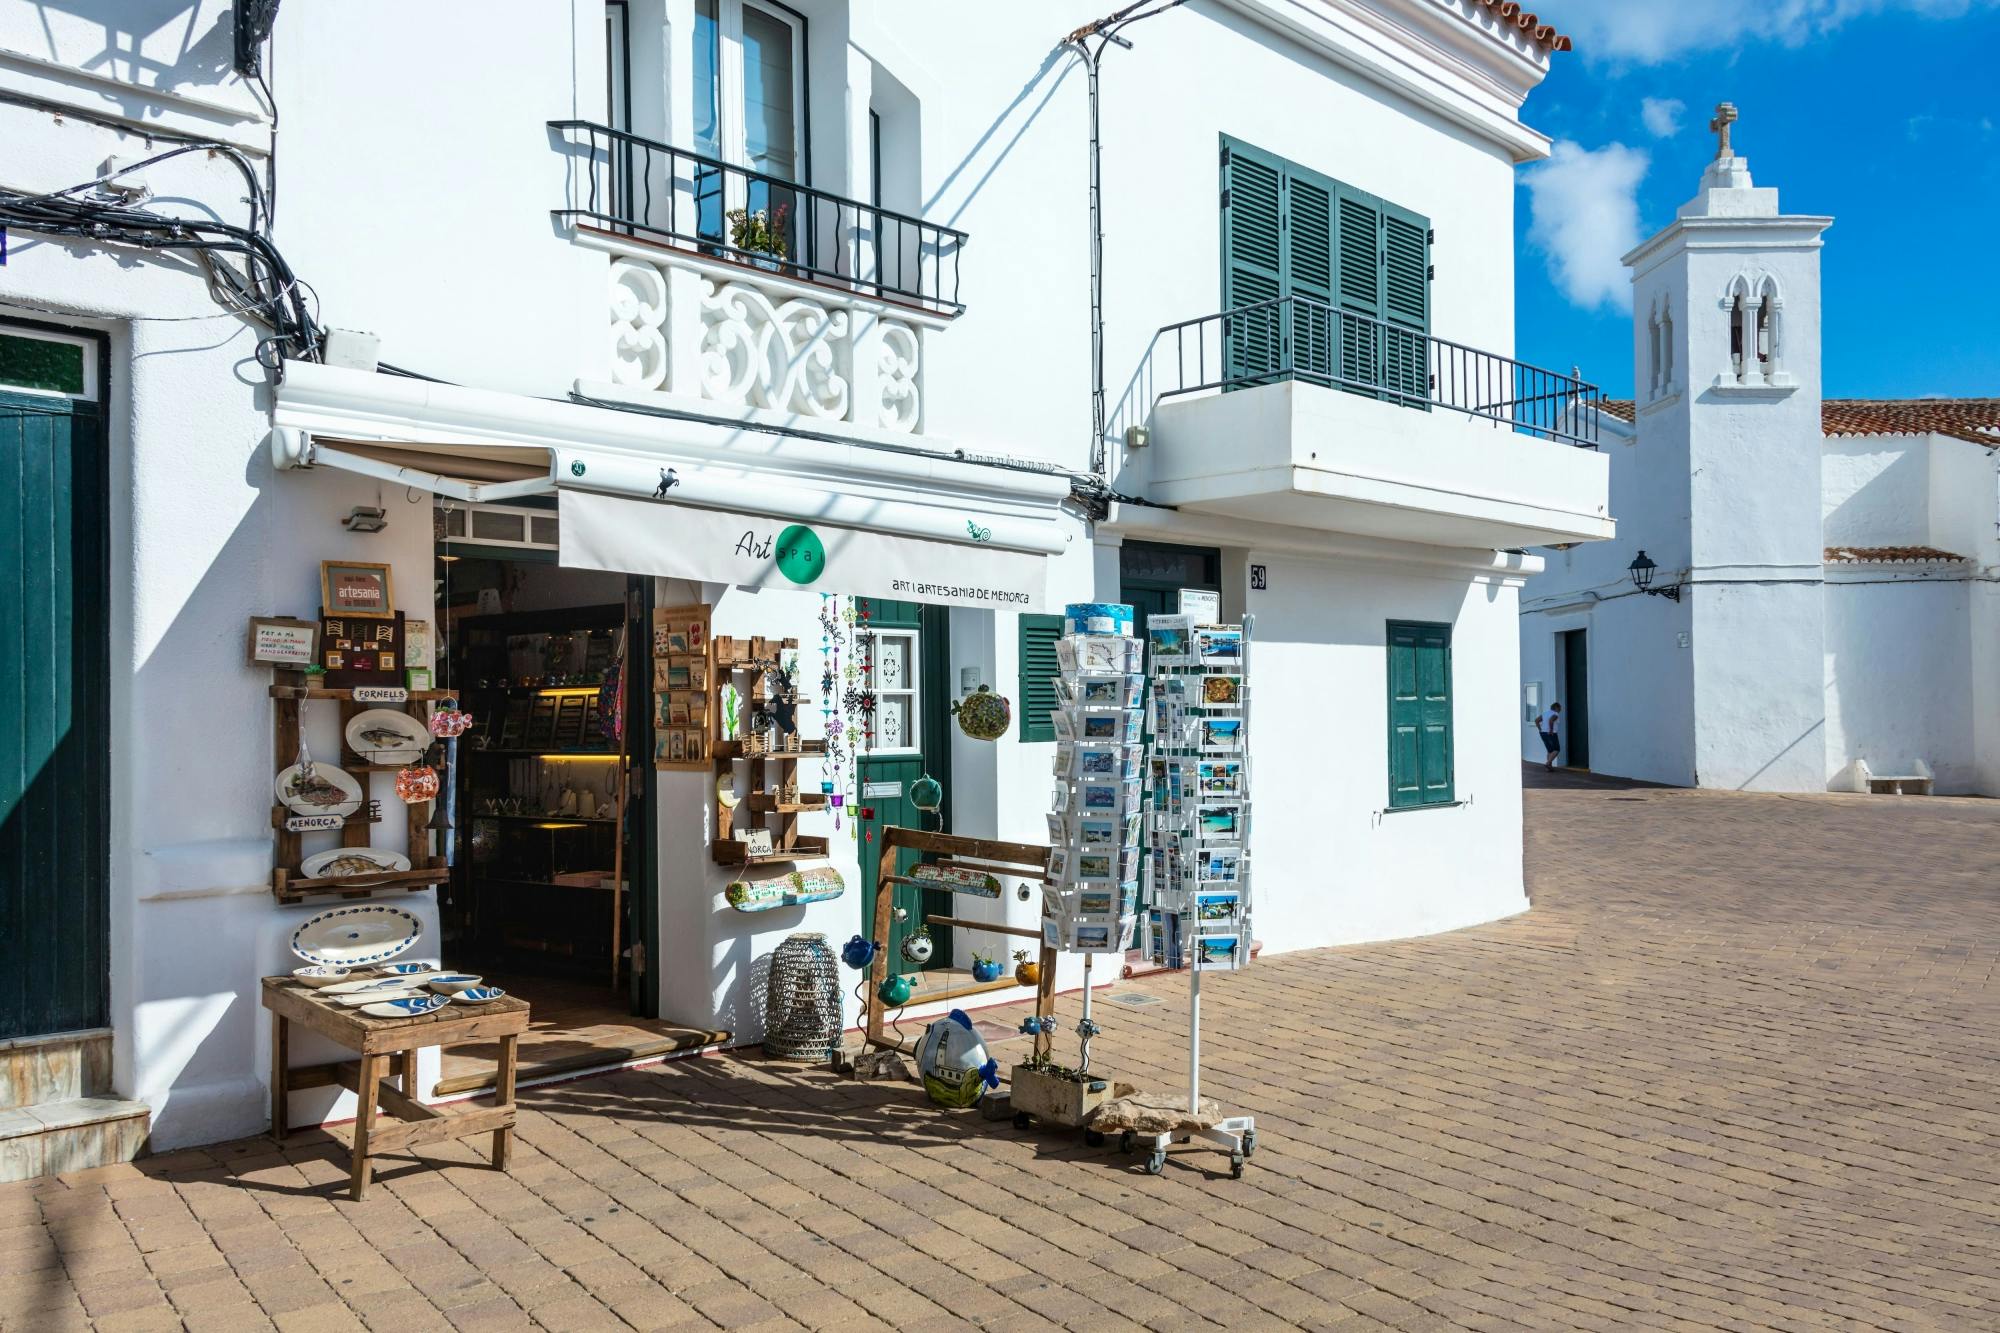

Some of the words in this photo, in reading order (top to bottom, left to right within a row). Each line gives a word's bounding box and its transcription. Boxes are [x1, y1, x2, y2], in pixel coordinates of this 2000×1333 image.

[735, 530, 772, 560] Art
[1251, 567, 1265, 588] 59
[977, 588, 990, 600] DE
[359, 690, 405, 699] FORNELLS
[291, 817, 337, 828] MENORCA
